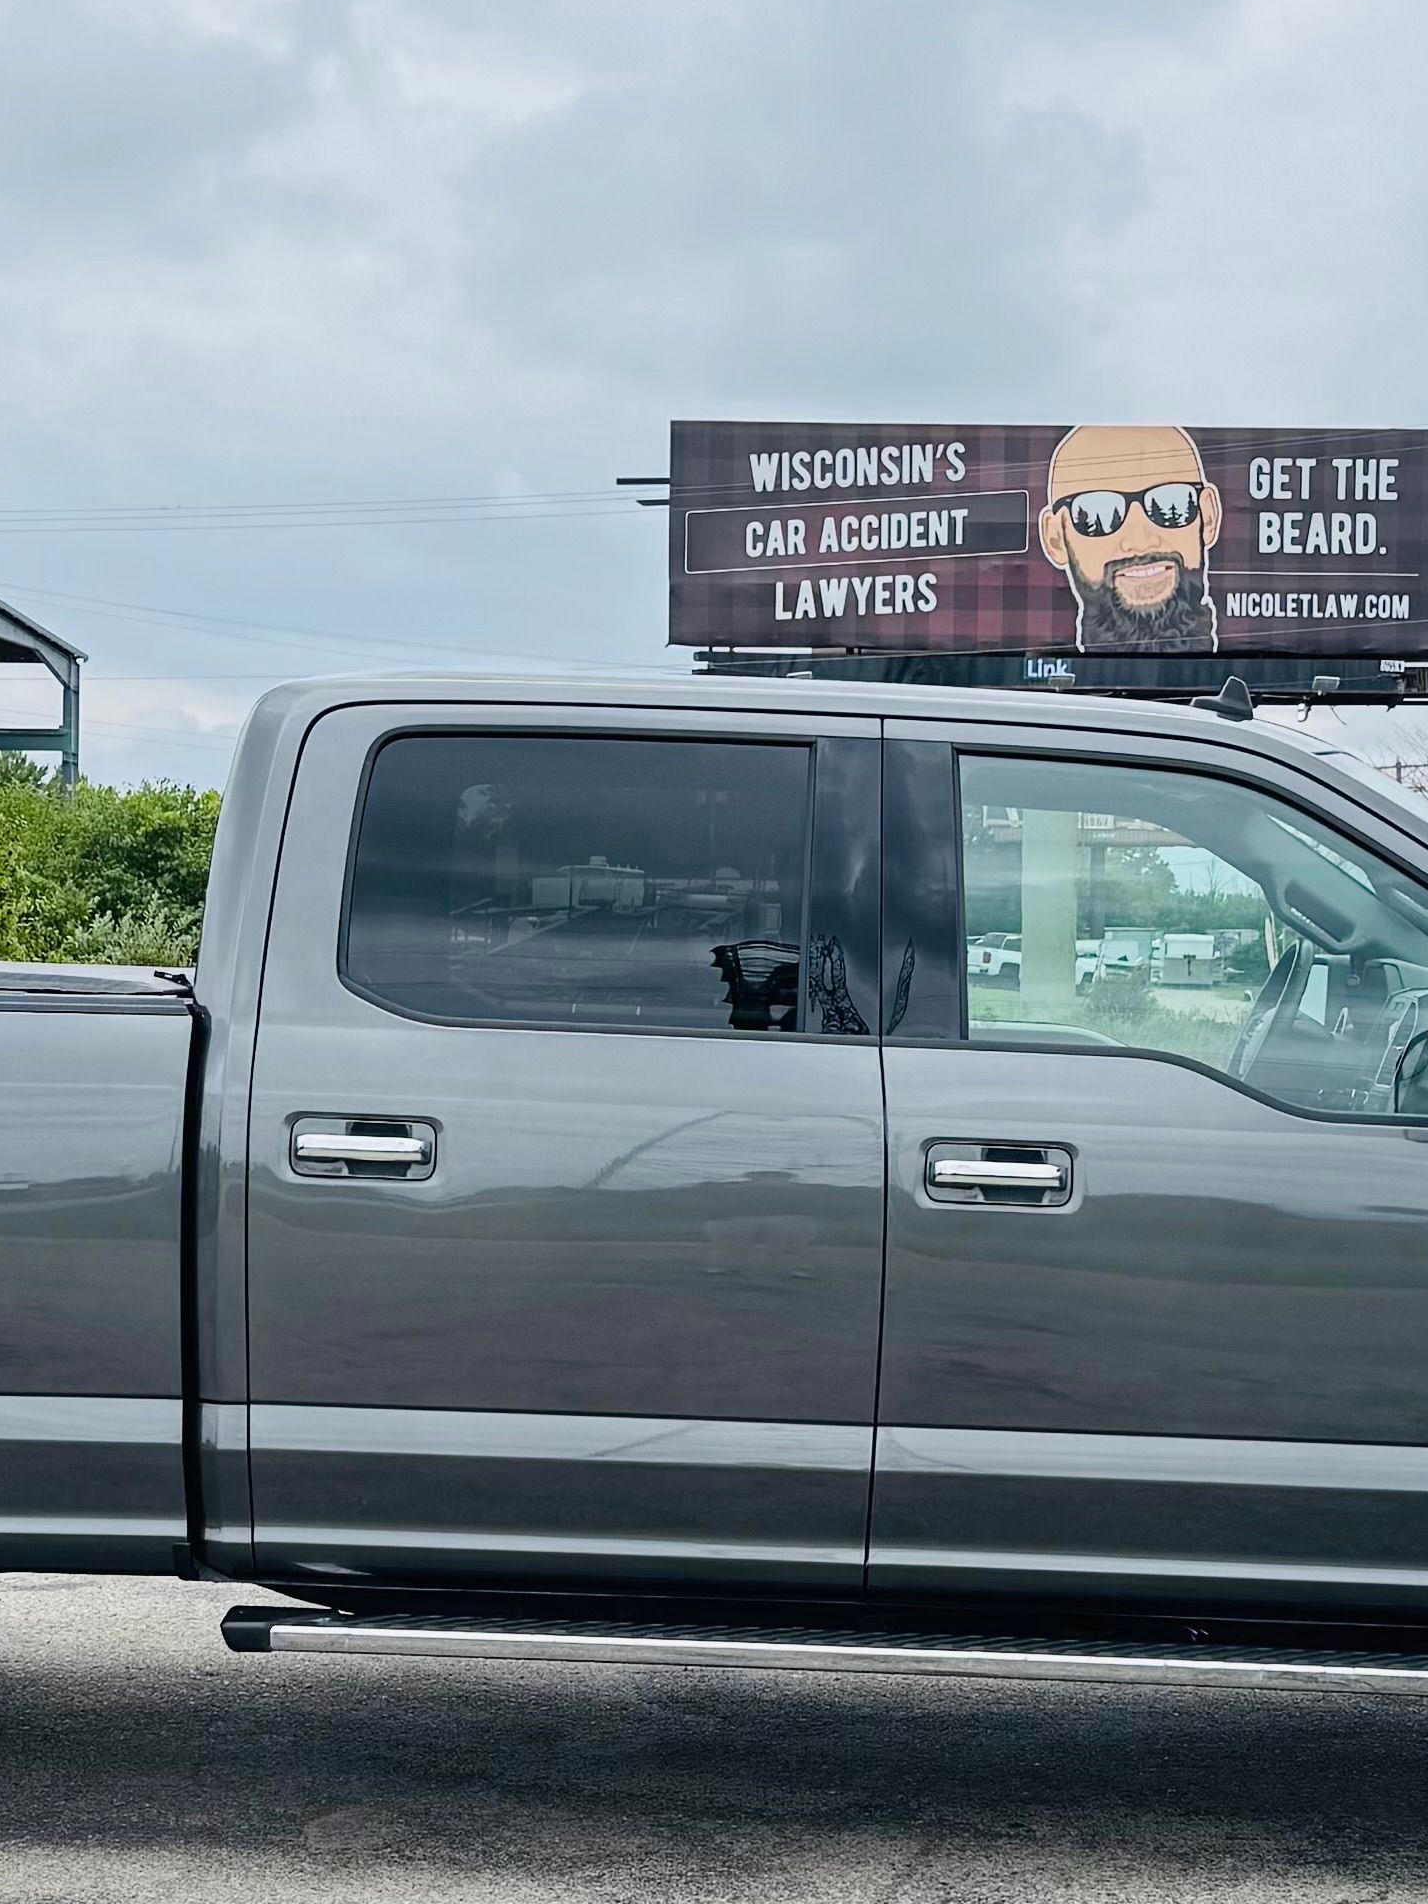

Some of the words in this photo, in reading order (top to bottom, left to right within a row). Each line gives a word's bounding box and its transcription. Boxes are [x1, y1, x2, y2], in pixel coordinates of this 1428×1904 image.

[749, 442, 966, 493] WISCONSIN'S
[1249, 457, 1316, 500] GET
[1332, 458, 1399, 501] THE
[745, 519, 806, 558] CAR
[819, 508, 968, 553] ACCIDENT
[1258, 512, 1387, 555] BEARD.
[775, 573, 938, 621] LAWYERS
[1226, 592, 1410, 619] NICOLETLAW.COM
[1027, 658, 1068, 678] Link
